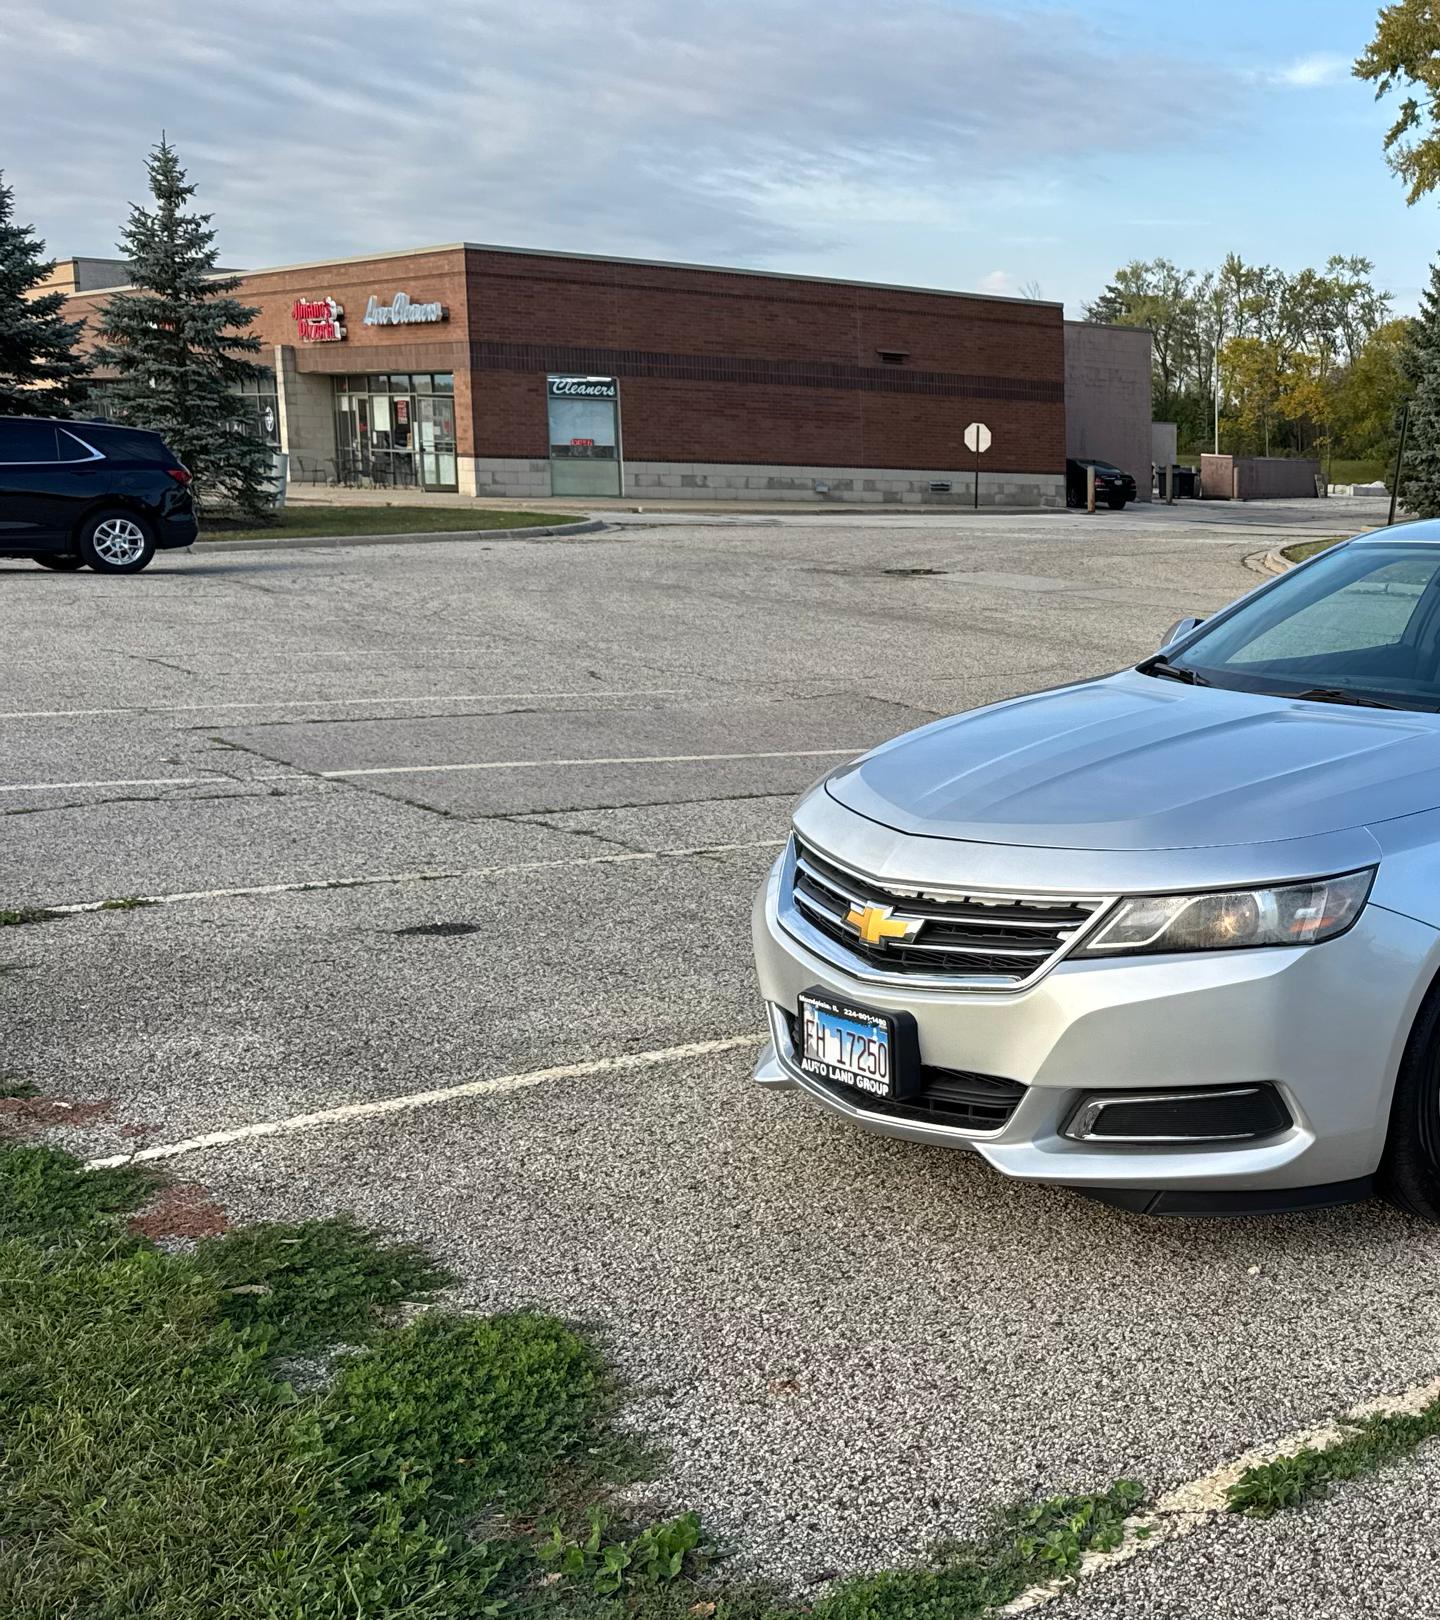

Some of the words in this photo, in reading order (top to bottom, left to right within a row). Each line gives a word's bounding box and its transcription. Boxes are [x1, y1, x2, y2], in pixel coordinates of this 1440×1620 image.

[552, 379, 616, 396] Cleaners
[806, 1018, 826, 1059] FH
[836, 1028, 888, 1078] 17250
[801, 1057, 827, 1076] AUTO
[829, 1066, 855, 1085] LAND
[856, 1075, 889, 1097] GROUP
